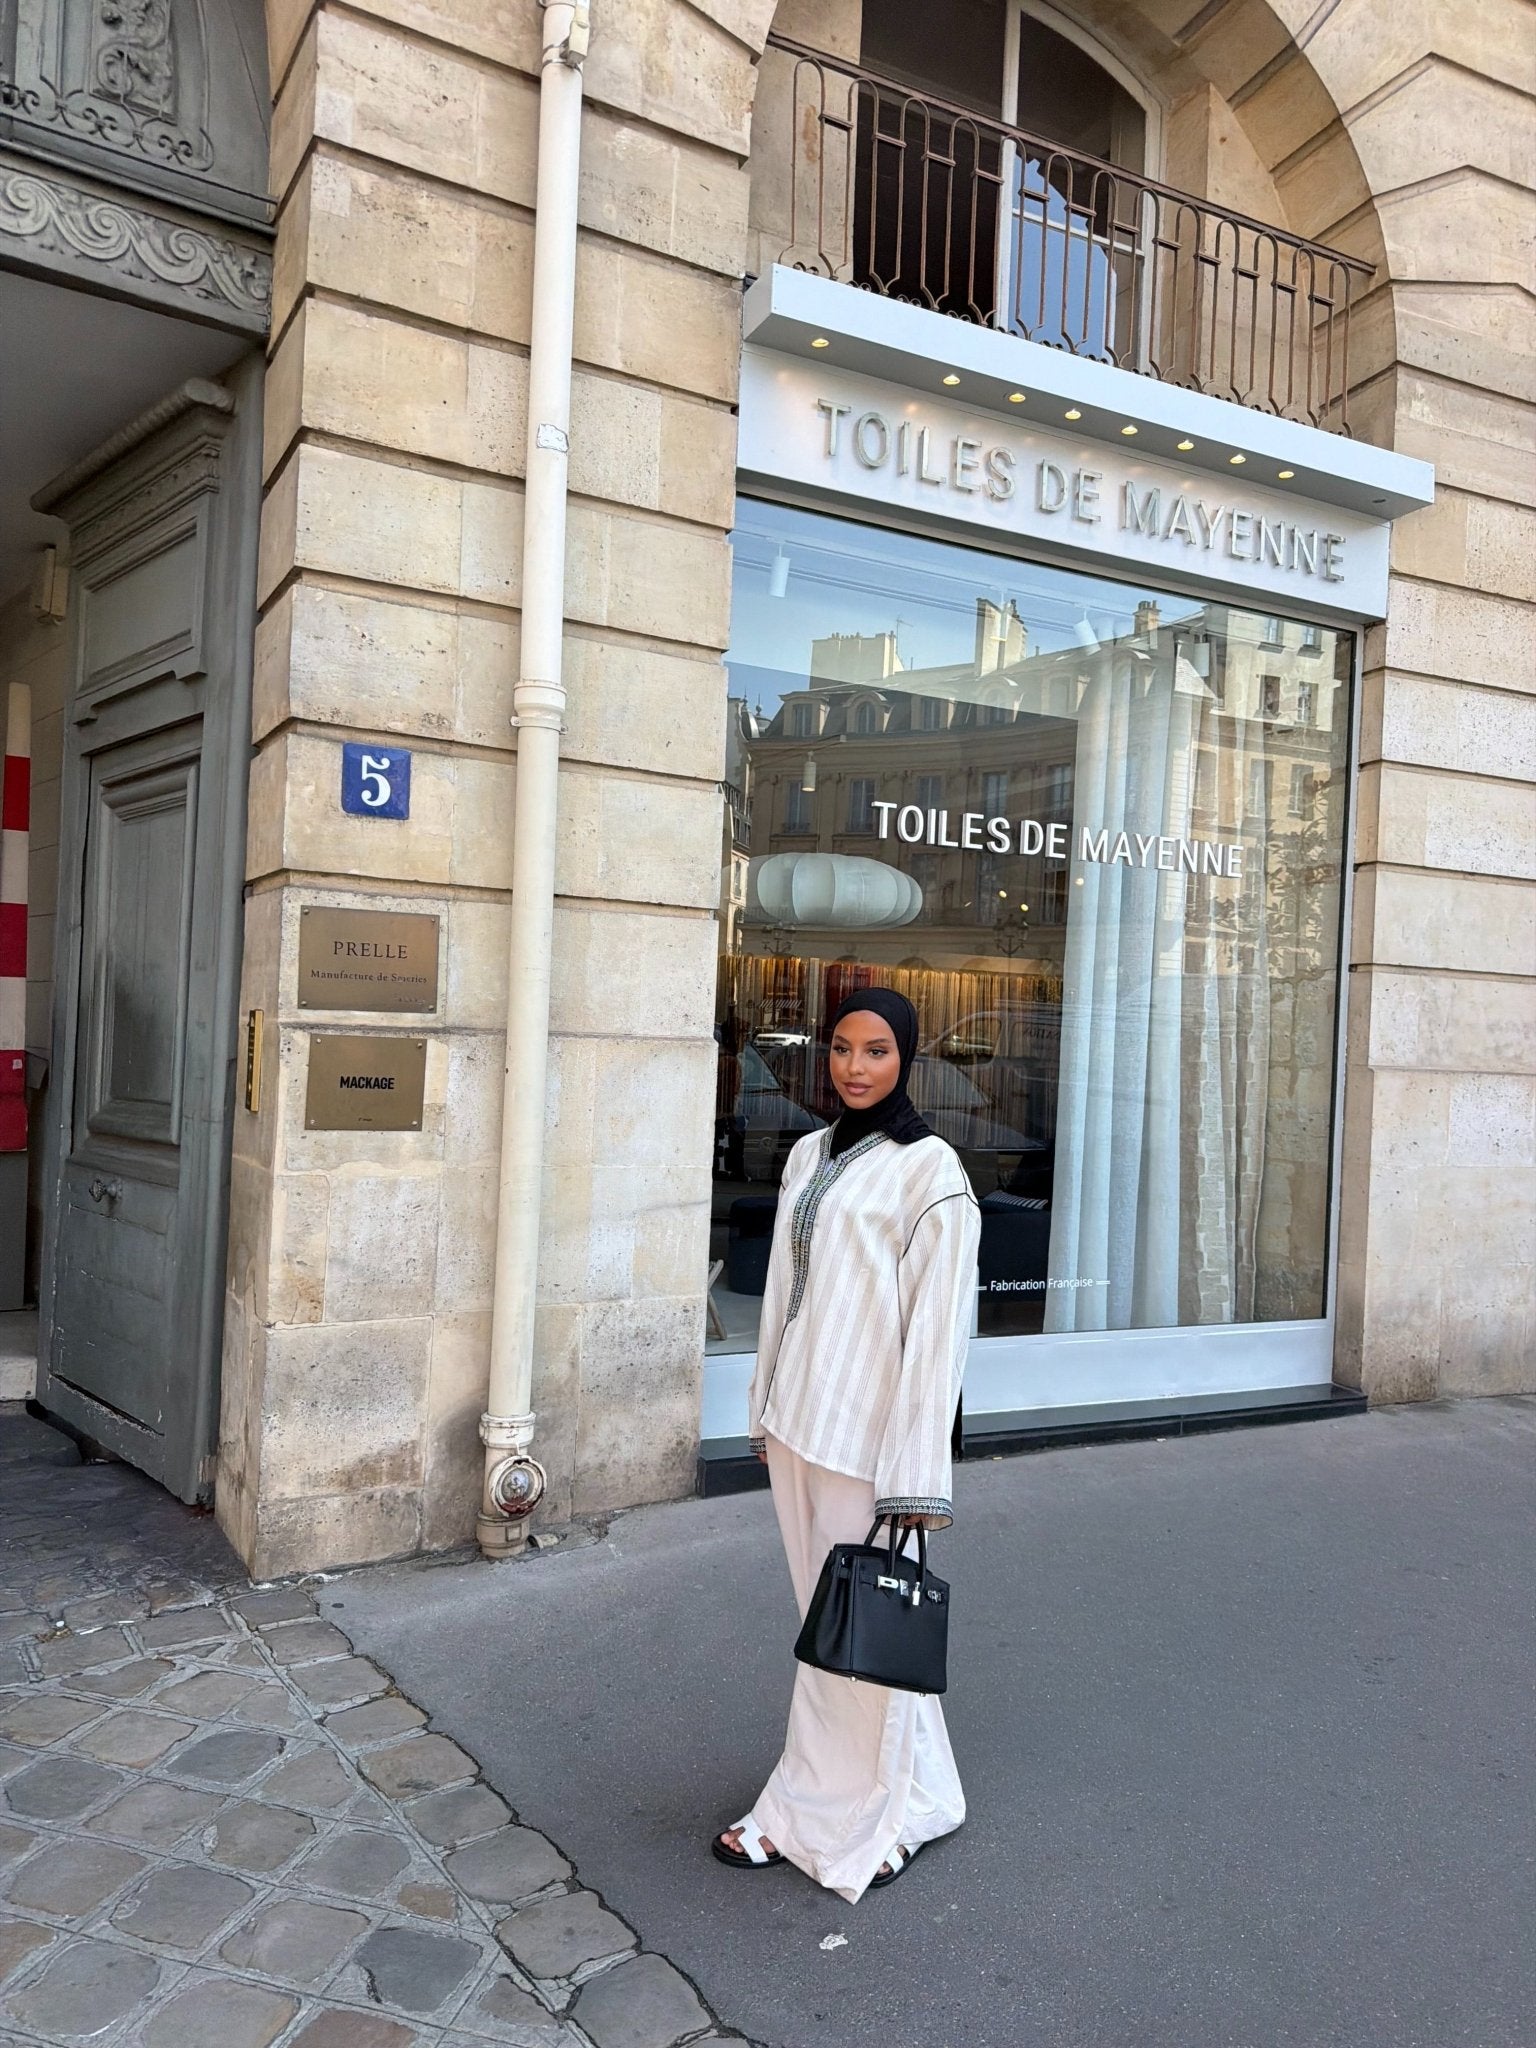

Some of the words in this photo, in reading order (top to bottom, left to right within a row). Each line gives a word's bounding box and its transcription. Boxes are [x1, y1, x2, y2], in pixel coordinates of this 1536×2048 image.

[817, 398, 1017, 501] TOILES
[1038, 457, 1103, 523] DE
[1121, 480, 1346, 583] MAYENNE
[361, 754, 391, 807] 5
[871, 800, 1011, 854] TOILES
[1019, 820, 1068, 859] DE
[1077, 826, 1244, 878] MAYENNE
[333, 941, 408, 959] PRELLE
[310, 969, 374, 981] Manufacture
[376, 972, 388, 982] de
[340, 1076, 395, 1090] MACKAGE
[990, 1279, 1046, 1292] Fabrication
[1048, 1276, 1093, 1292] Française
